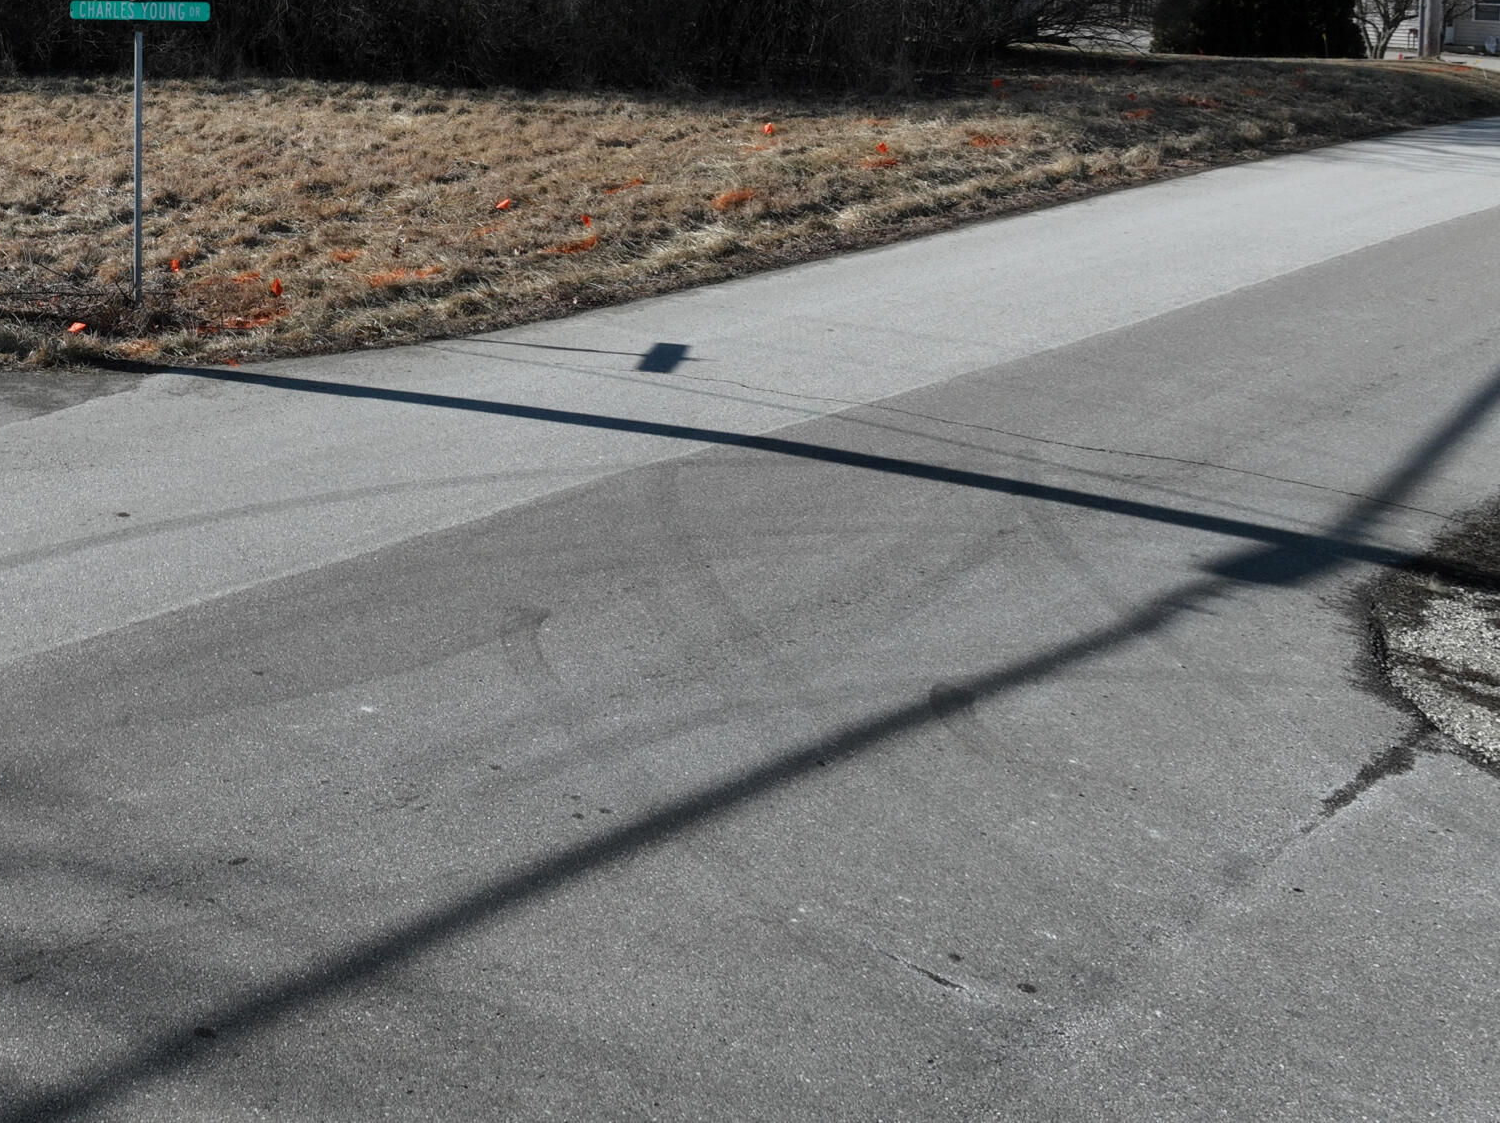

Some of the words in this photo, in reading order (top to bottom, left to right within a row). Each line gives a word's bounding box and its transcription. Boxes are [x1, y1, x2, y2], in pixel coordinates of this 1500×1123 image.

[79, 1, 134, 19] CHARLES
[141, 2, 185, 20] YOUNG
[189, 7, 201, 18] DR
